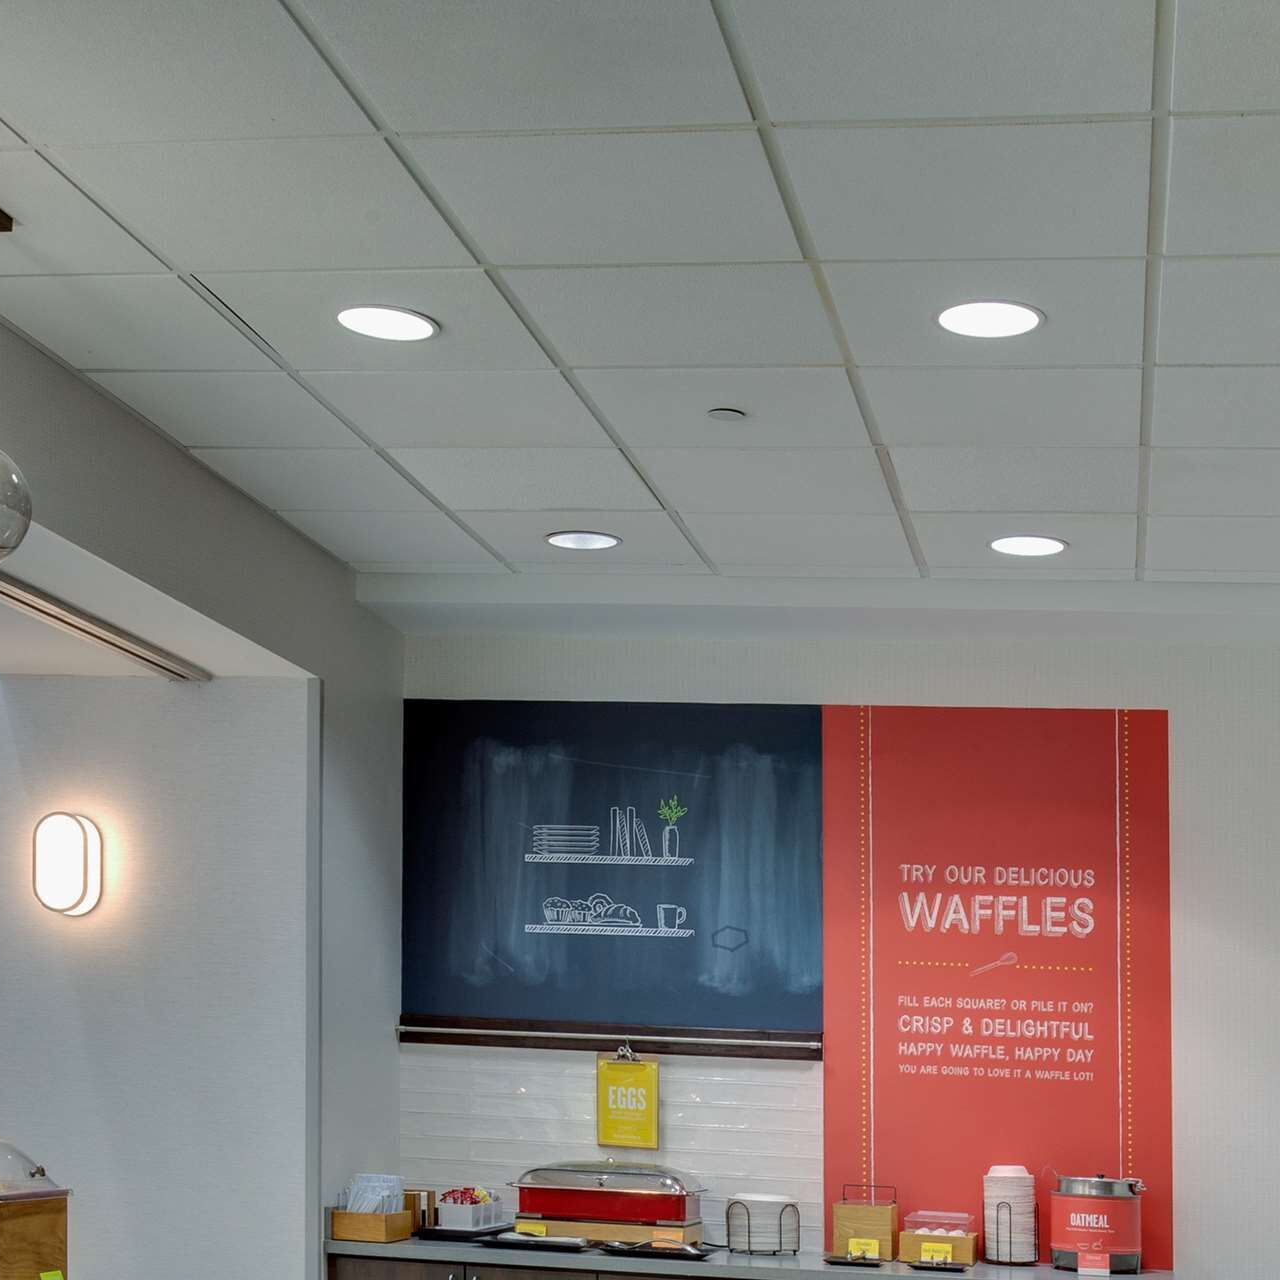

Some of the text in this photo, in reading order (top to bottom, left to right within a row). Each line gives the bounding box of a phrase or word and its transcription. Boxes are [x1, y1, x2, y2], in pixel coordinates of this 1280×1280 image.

[899, 864, 1095, 888] TRY OUR DELICIOUS
[899, 891, 1095, 938] WAFFLES
[898, 995, 1094, 1013] FILL EACH SQUARE? OR PILE IT ON?
[898, 1015, 1094, 1041] CRISP & DELIGHTFUL
[898, 1042, 1095, 1063] HAPPY WAFFLE, HAPPY DAY
[898, 1064, 1094, 1082] YOU ARE GOING TO LOVE IT A WAFFLE LOT!
[608, 1086, 647, 1111] EGGS
[1070, 1212, 1110, 1228] OATMEAL
